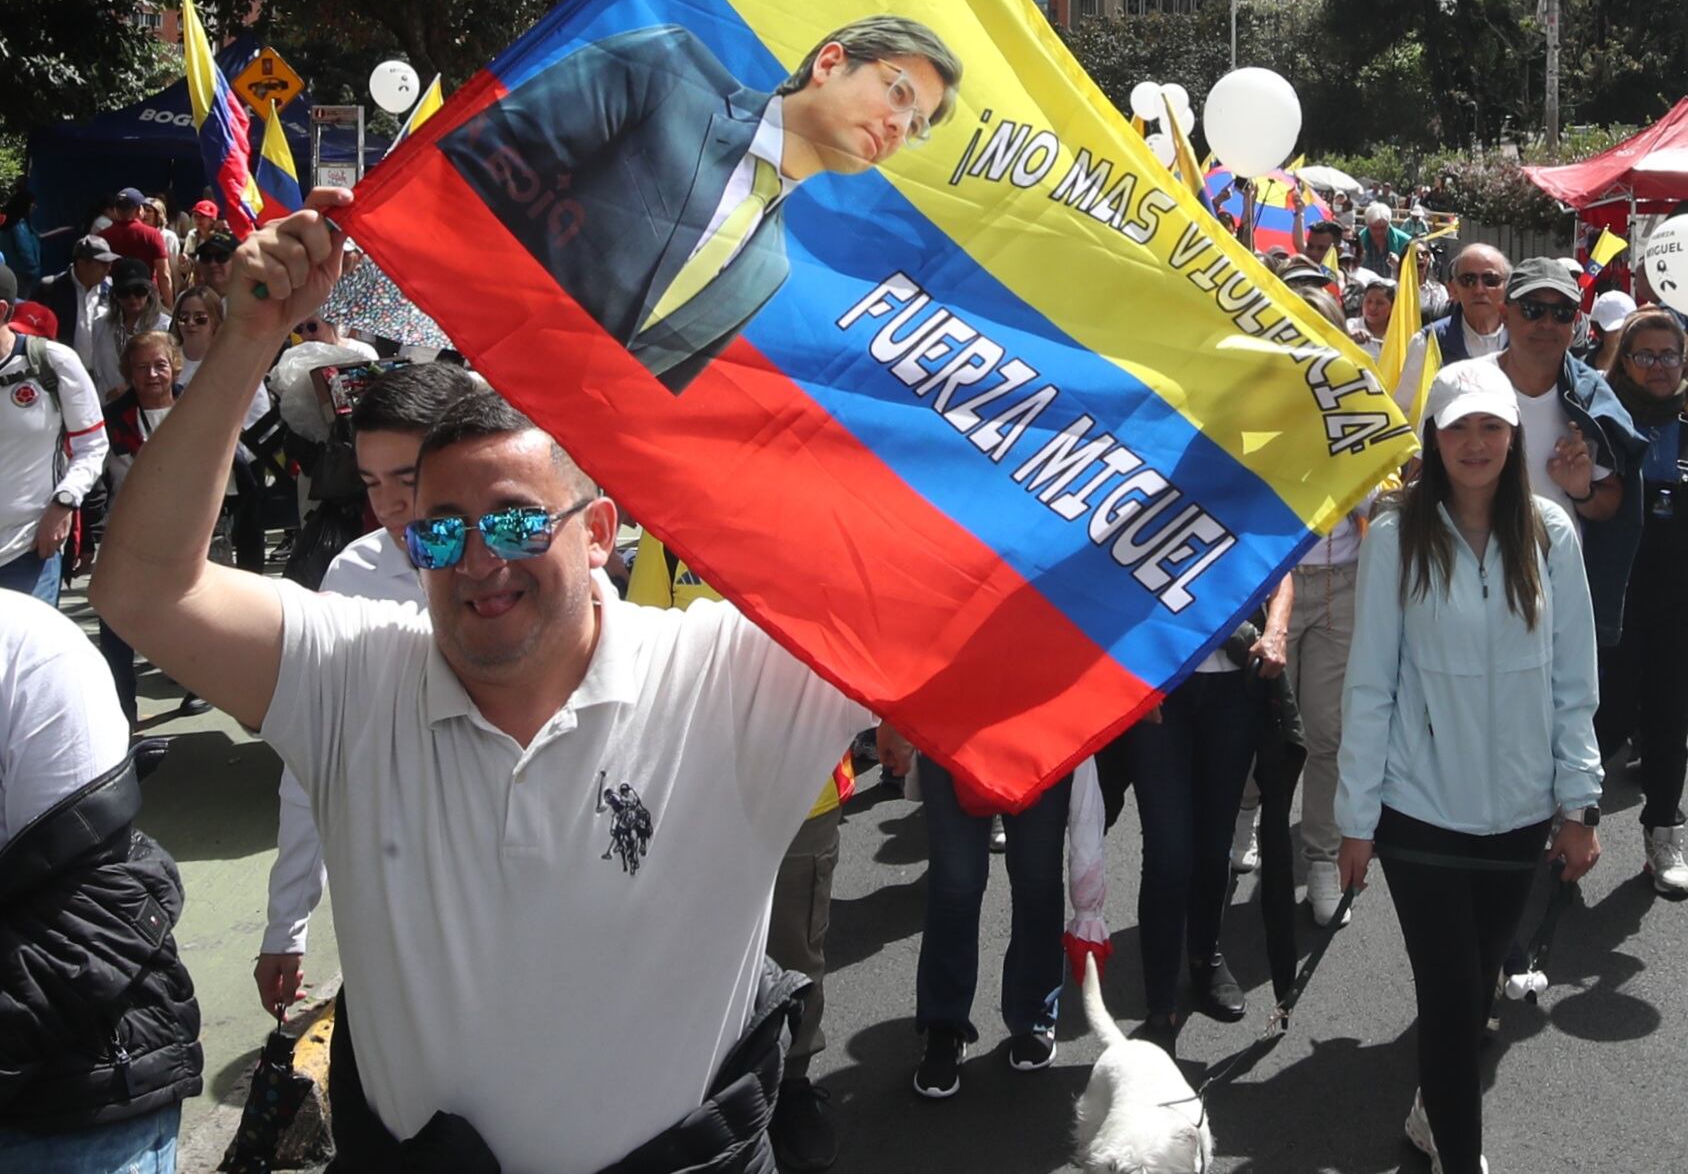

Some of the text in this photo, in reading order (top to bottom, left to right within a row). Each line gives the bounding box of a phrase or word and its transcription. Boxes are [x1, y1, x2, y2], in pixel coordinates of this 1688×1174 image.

[138, 108, 194, 127] BOG
[948, 108, 1060, 189] ¡NO
[1048, 146, 1178, 245] MAS
[1646, 242, 1684, 259] MIGUEL
[837, 269, 1238, 615] FUERZA MIGUEL
